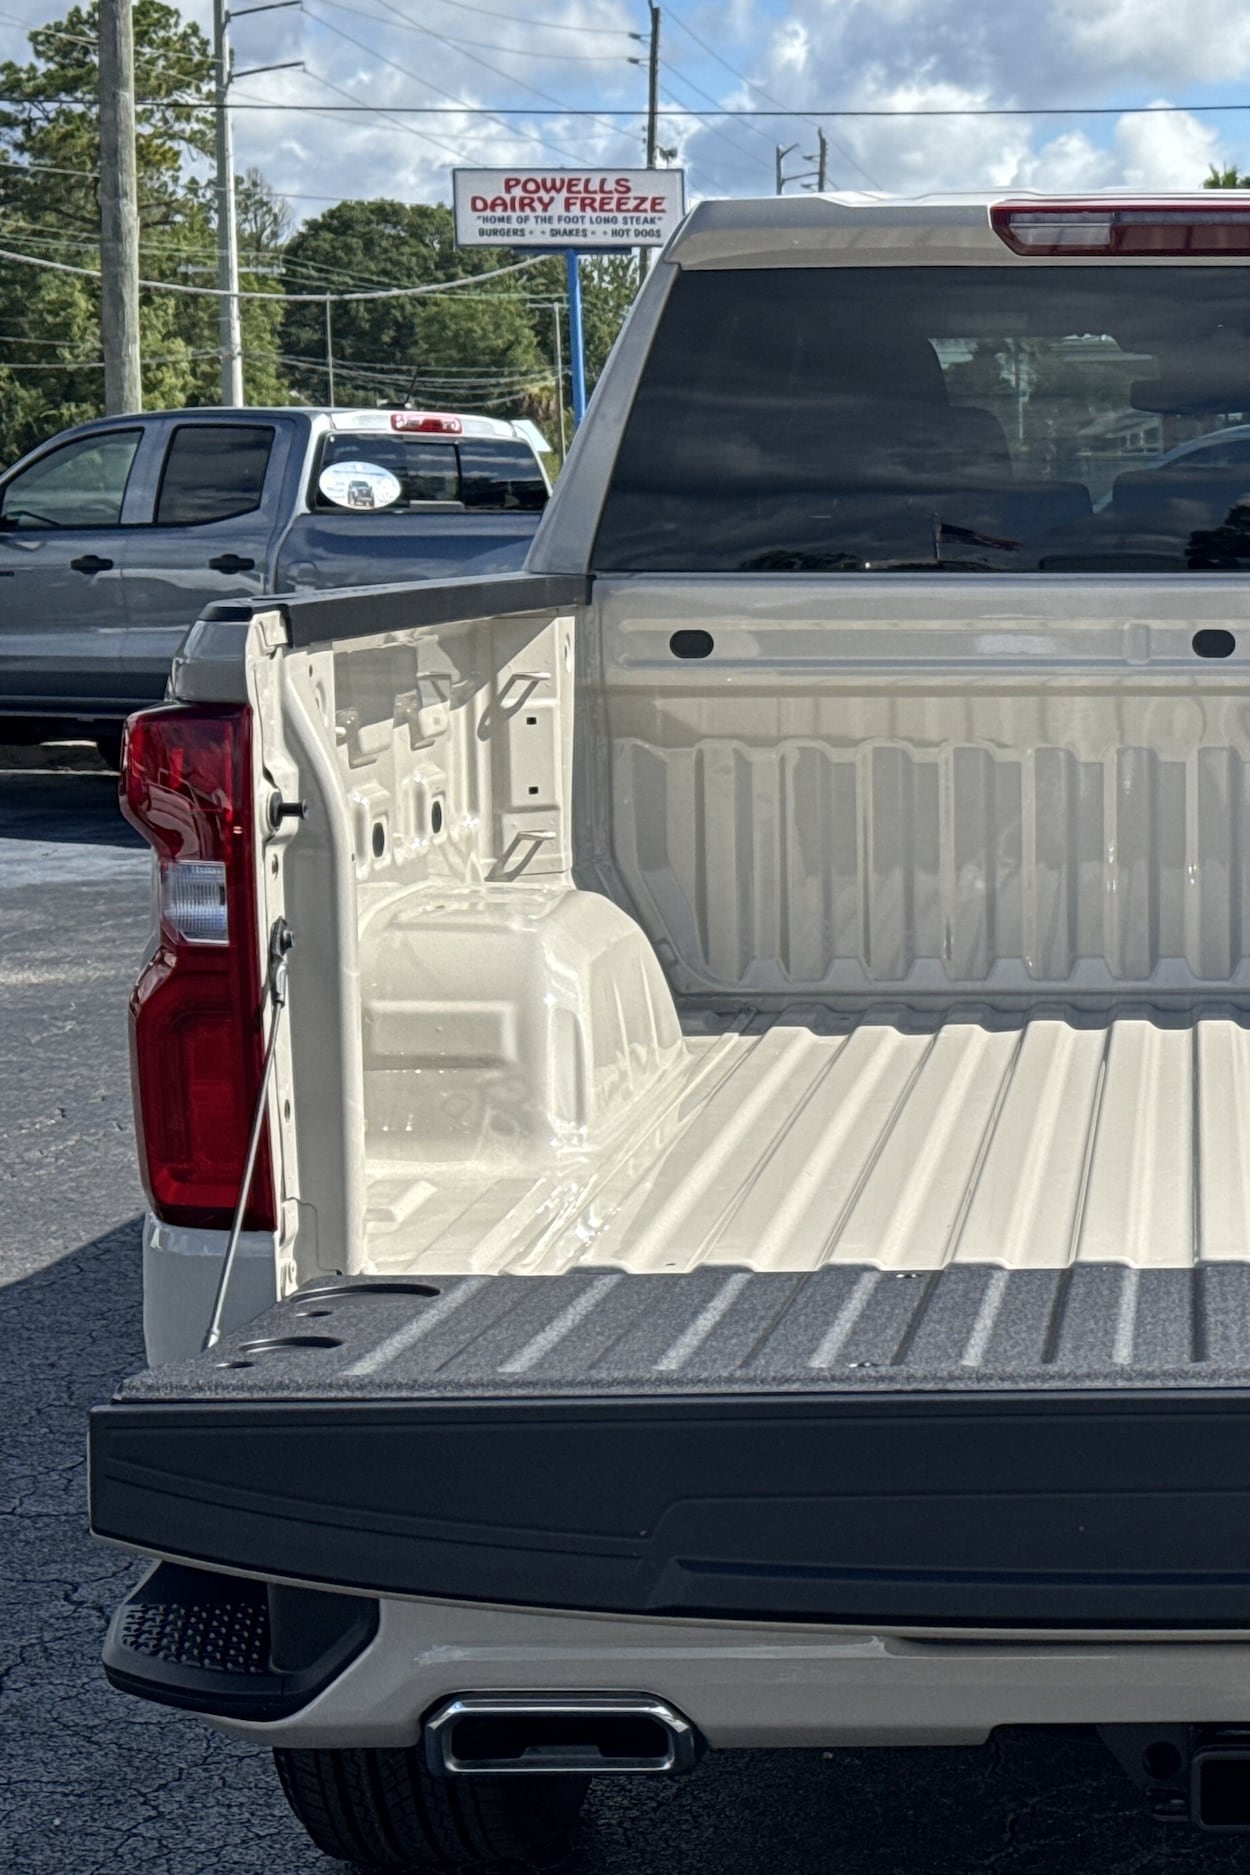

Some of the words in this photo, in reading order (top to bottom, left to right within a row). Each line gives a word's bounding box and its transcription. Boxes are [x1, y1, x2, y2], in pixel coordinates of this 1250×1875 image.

[504, 177, 632, 195] POWELLS
[470, 196, 555, 213] DAIRY
[564, 196, 667, 213] FREEZE
[516, 215, 530, 224] OF
[535, 216, 554, 224] THE
[557, 216, 585, 224] FOOT
[589, 216, 618, 225] LONG
[478, 227, 526, 237] BURGERS
[549, 228, 588, 238] SHAKES
[611, 228, 632, 237] HOT
[634, 228, 662, 238] DOGS
